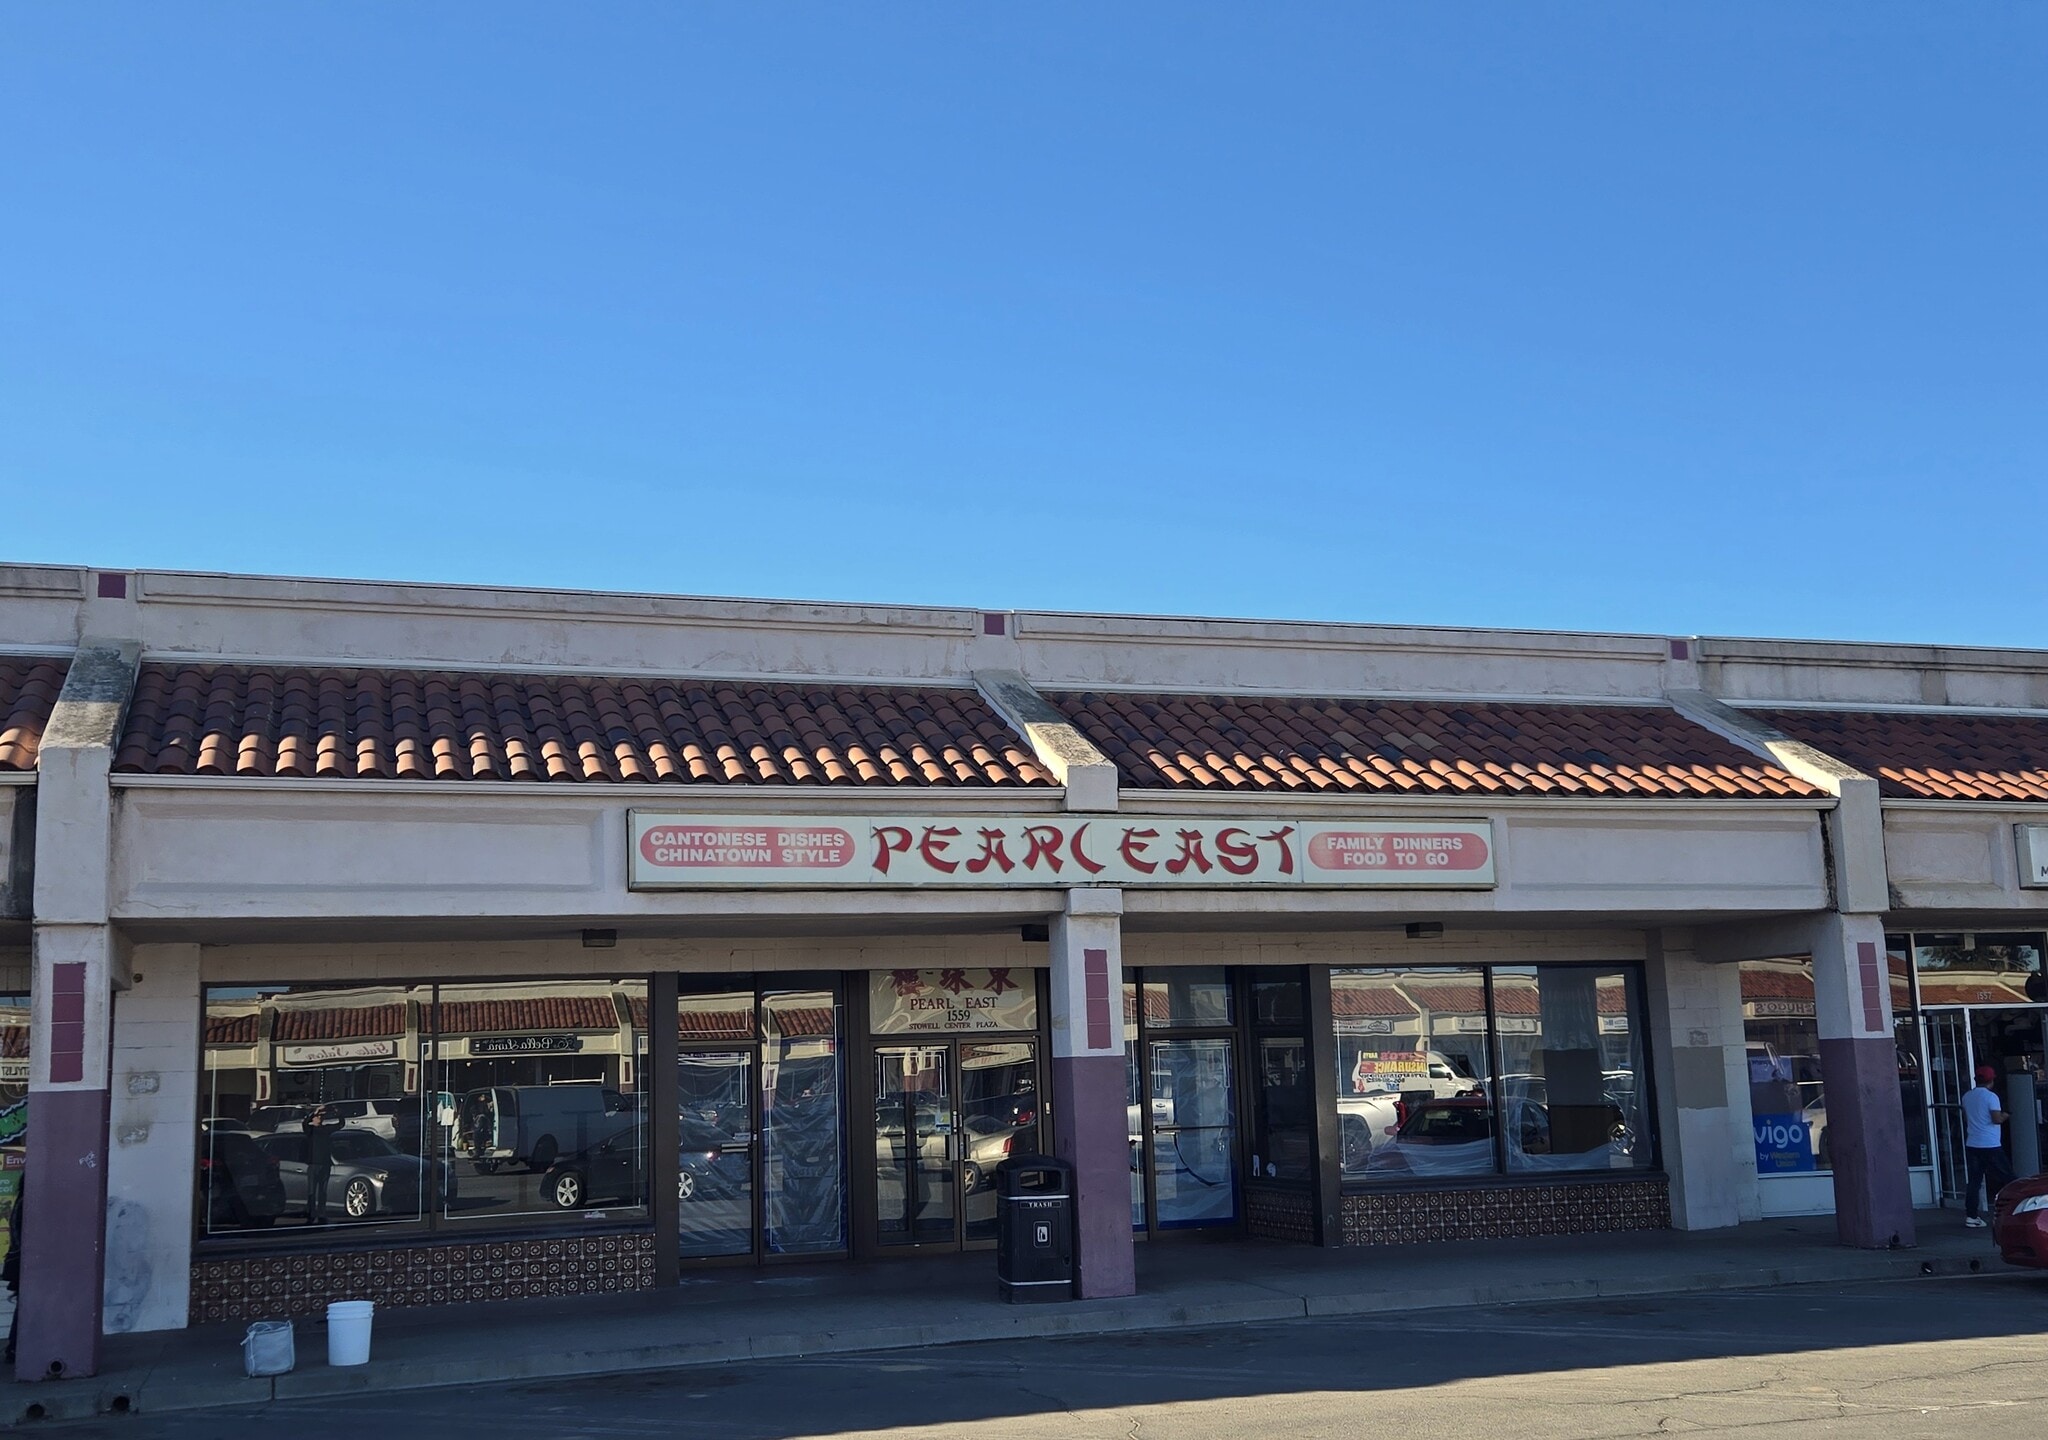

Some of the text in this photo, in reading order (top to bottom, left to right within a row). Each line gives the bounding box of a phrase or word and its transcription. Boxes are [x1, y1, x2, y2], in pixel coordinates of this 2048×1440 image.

[650, 831, 846, 847] CANTONESE DISHES
[1327, 837, 1464, 851] FAMILY DINNERS
[654, 848, 841, 863] CHINATOWN STYLE
[870, 822, 1295, 876] PEARL EAST
[1343, 852, 1449, 866] FOOD TO GO
[910, 997, 999, 1010] PEARL EAST
[947, 1010, 971, 1022] 1559
[1754, 1119, 1803, 1149] vigo
